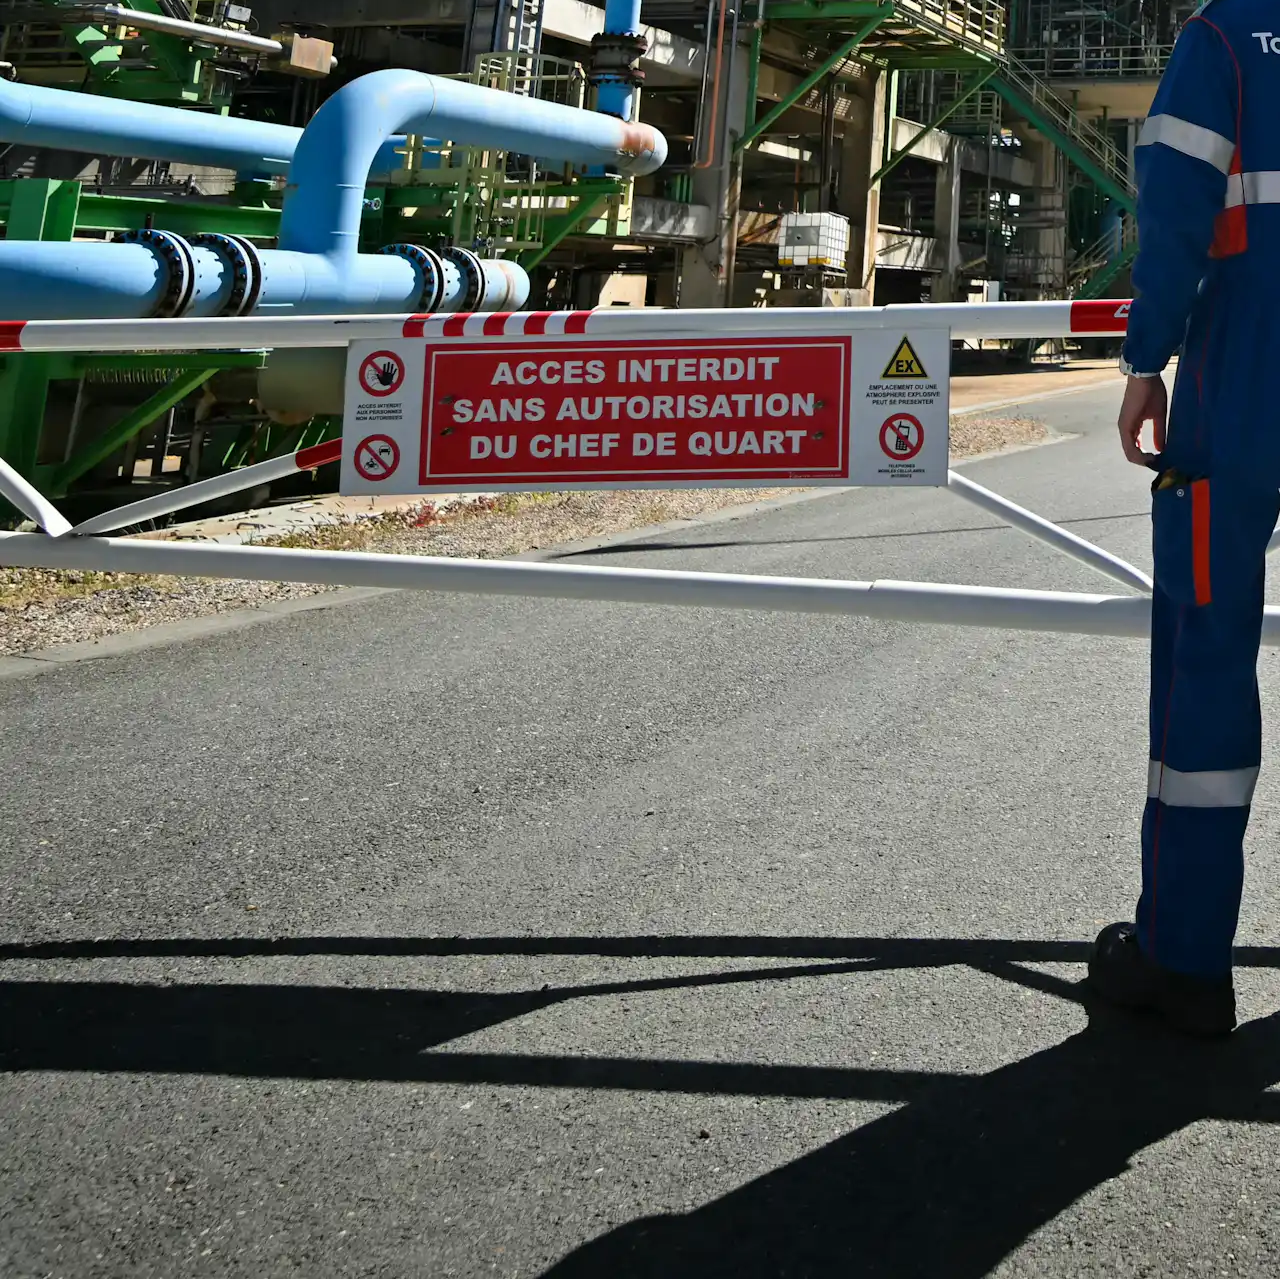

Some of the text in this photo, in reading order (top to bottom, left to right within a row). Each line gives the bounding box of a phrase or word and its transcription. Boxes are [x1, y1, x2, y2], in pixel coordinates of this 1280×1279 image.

[490, 356, 780, 386] ACCES INTERDIT
[895, 359, 914, 373] EX
[453, 392, 815, 423] SANS AUTORISATION
[470, 429, 807, 460] DU CHEF DE QUART
